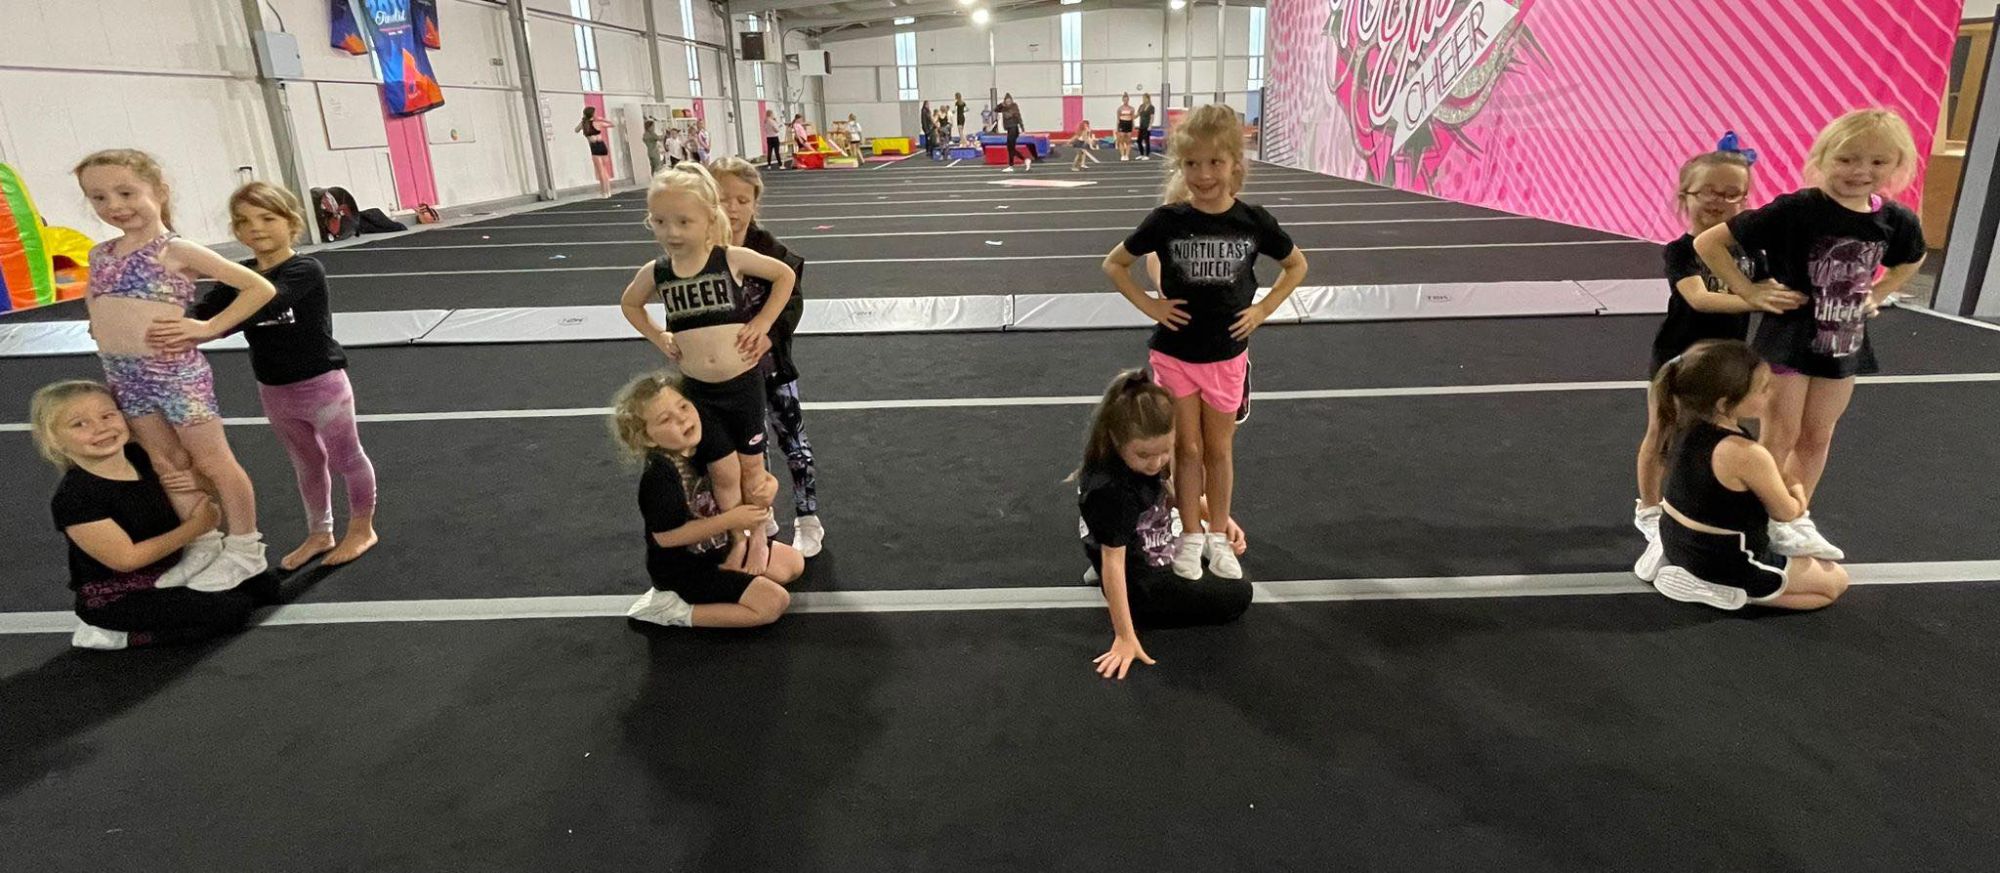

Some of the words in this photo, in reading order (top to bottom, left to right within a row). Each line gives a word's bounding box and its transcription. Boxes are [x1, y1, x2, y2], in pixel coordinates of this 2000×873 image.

[1403, 1, 1490, 130] CHEER
[1173, 242, 1215, 260] NORTH
[1219, 241, 1249, 260] EAST
[1191, 261, 1231, 278] CHEER
[661, 279, 731, 313] CHEER
